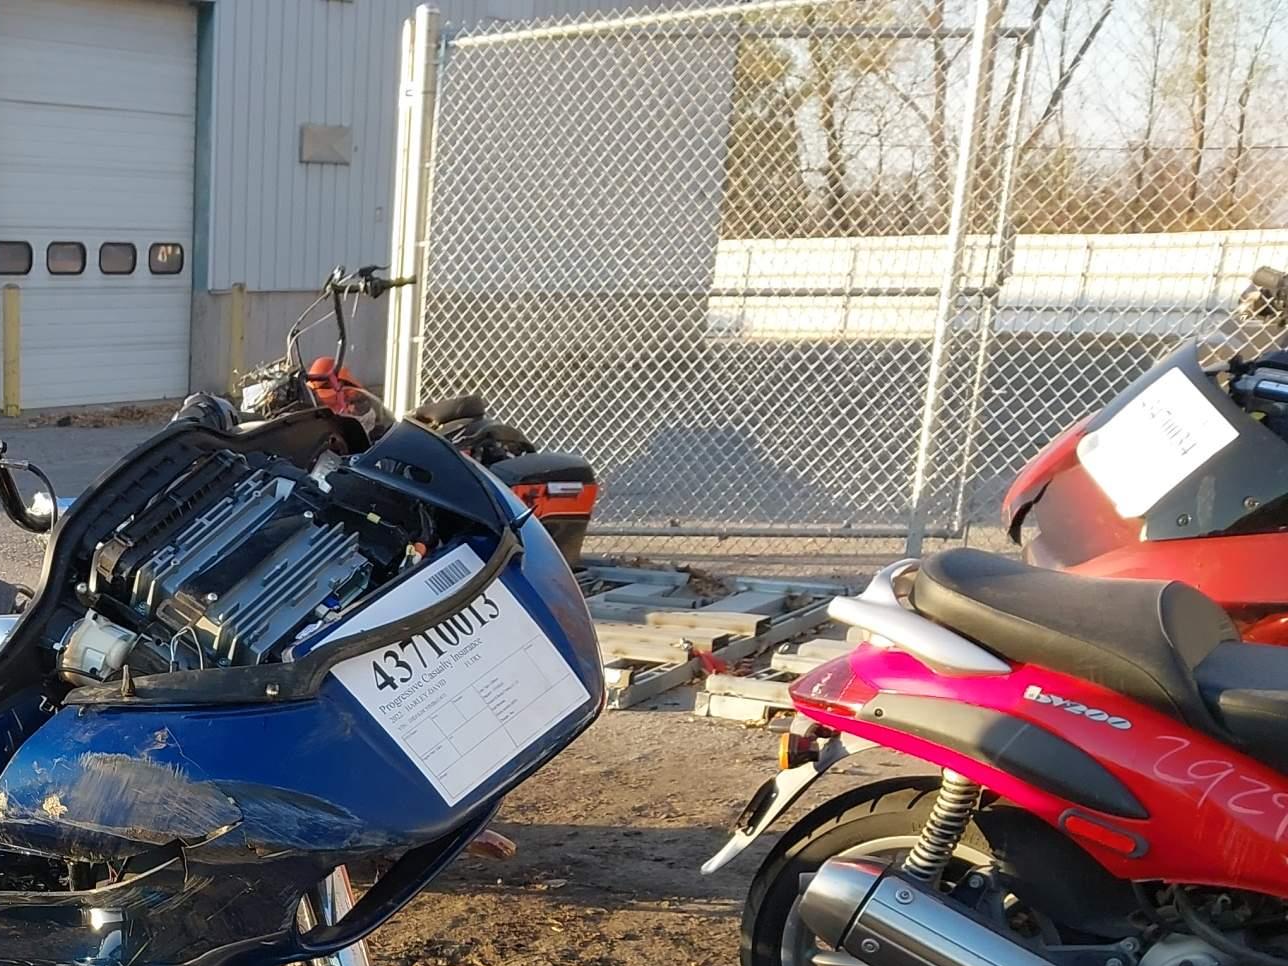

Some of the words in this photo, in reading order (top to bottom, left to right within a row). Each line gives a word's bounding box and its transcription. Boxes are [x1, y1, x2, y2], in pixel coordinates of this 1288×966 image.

[372, 592, 500, 691] 43710013
[379, 680, 424, 715] Progressive
[421, 660, 454, 684] Casualty
[450, 637, 483, 662] Insurance
